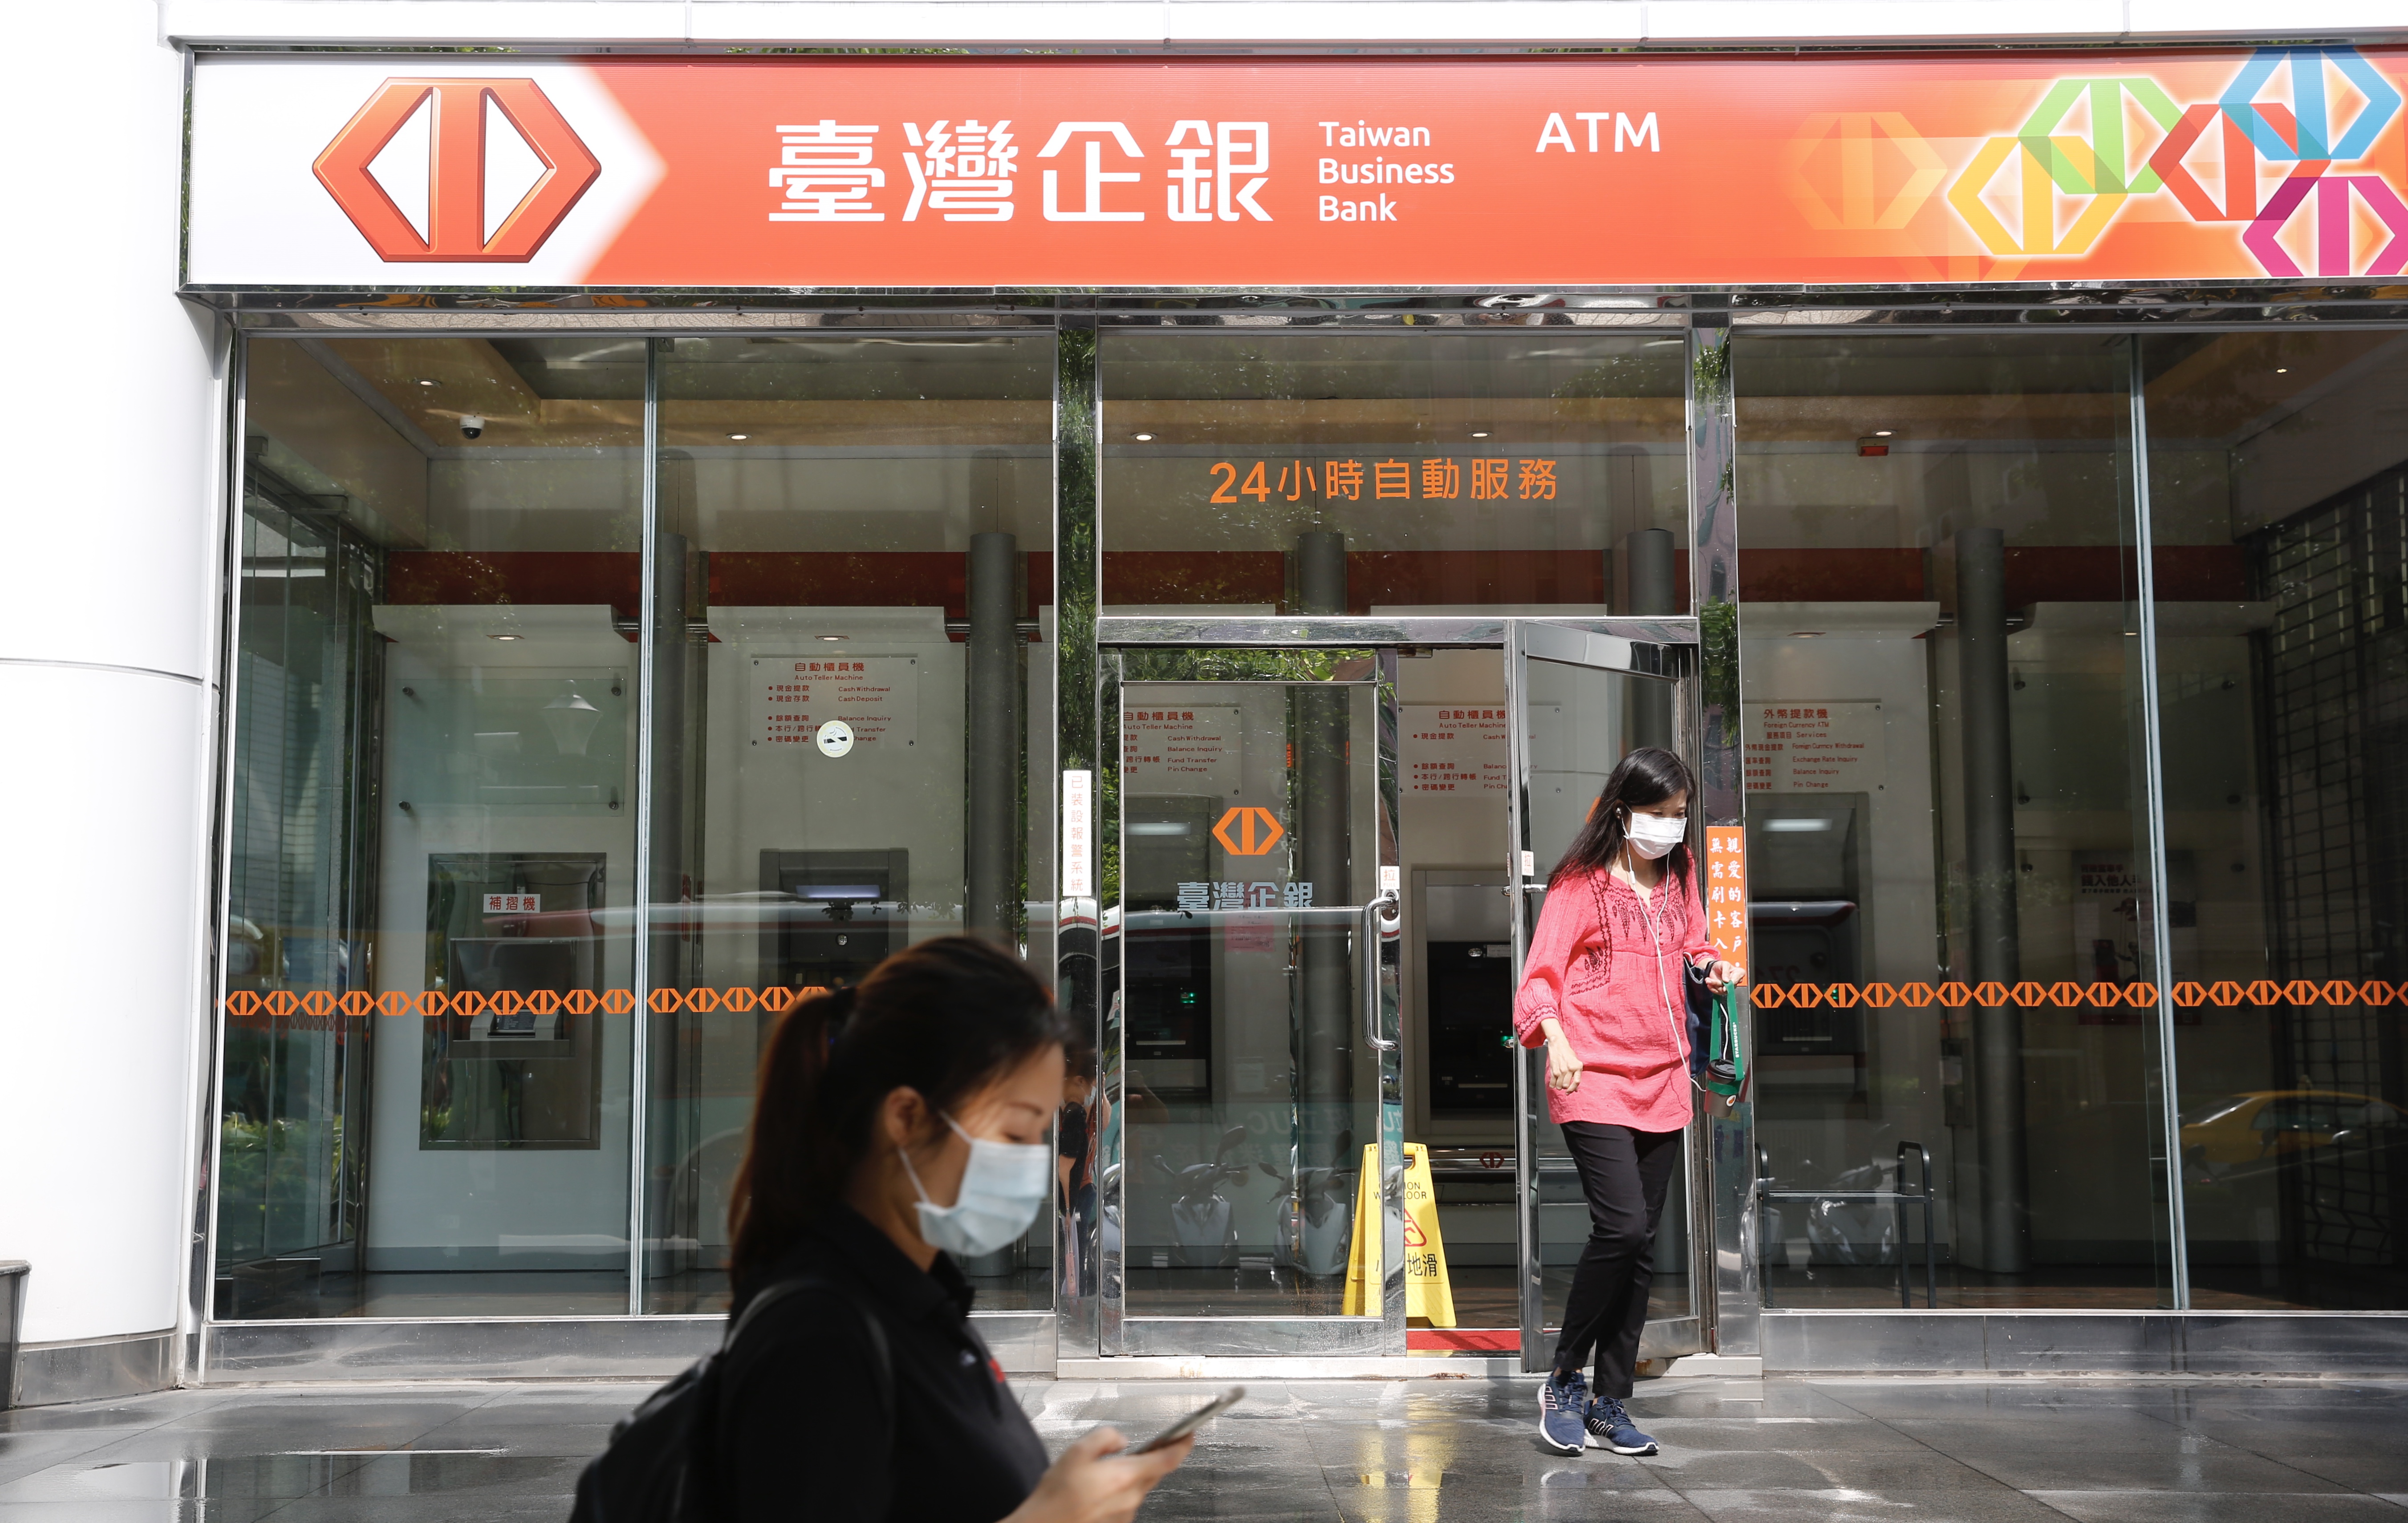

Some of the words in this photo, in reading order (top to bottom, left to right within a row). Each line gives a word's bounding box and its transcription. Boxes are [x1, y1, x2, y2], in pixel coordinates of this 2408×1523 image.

[1318, 121, 1430, 147] Taiwan
[1535, 112, 1661, 153] ATM
[768, 120, 1273, 222] 臺灣企銀
[1318, 158, 1454, 185] Business
[1318, 195, 1397, 222] Bank
[1210, 458, 1556, 503] 24小時自動服務
[795, 663, 864, 671] 自動櫃員機
[1124, 711, 1194, 721] 自動櫃員機
[1439, 710, 1505, 719] 自動櫃員機
[1764, 709, 1828, 719] 外幣提款機
[1384, 869, 1396, 881] 拉
[489, 896, 535, 911] 補摺機
[1177, 882, 1313, 911] 臺灣企銀
